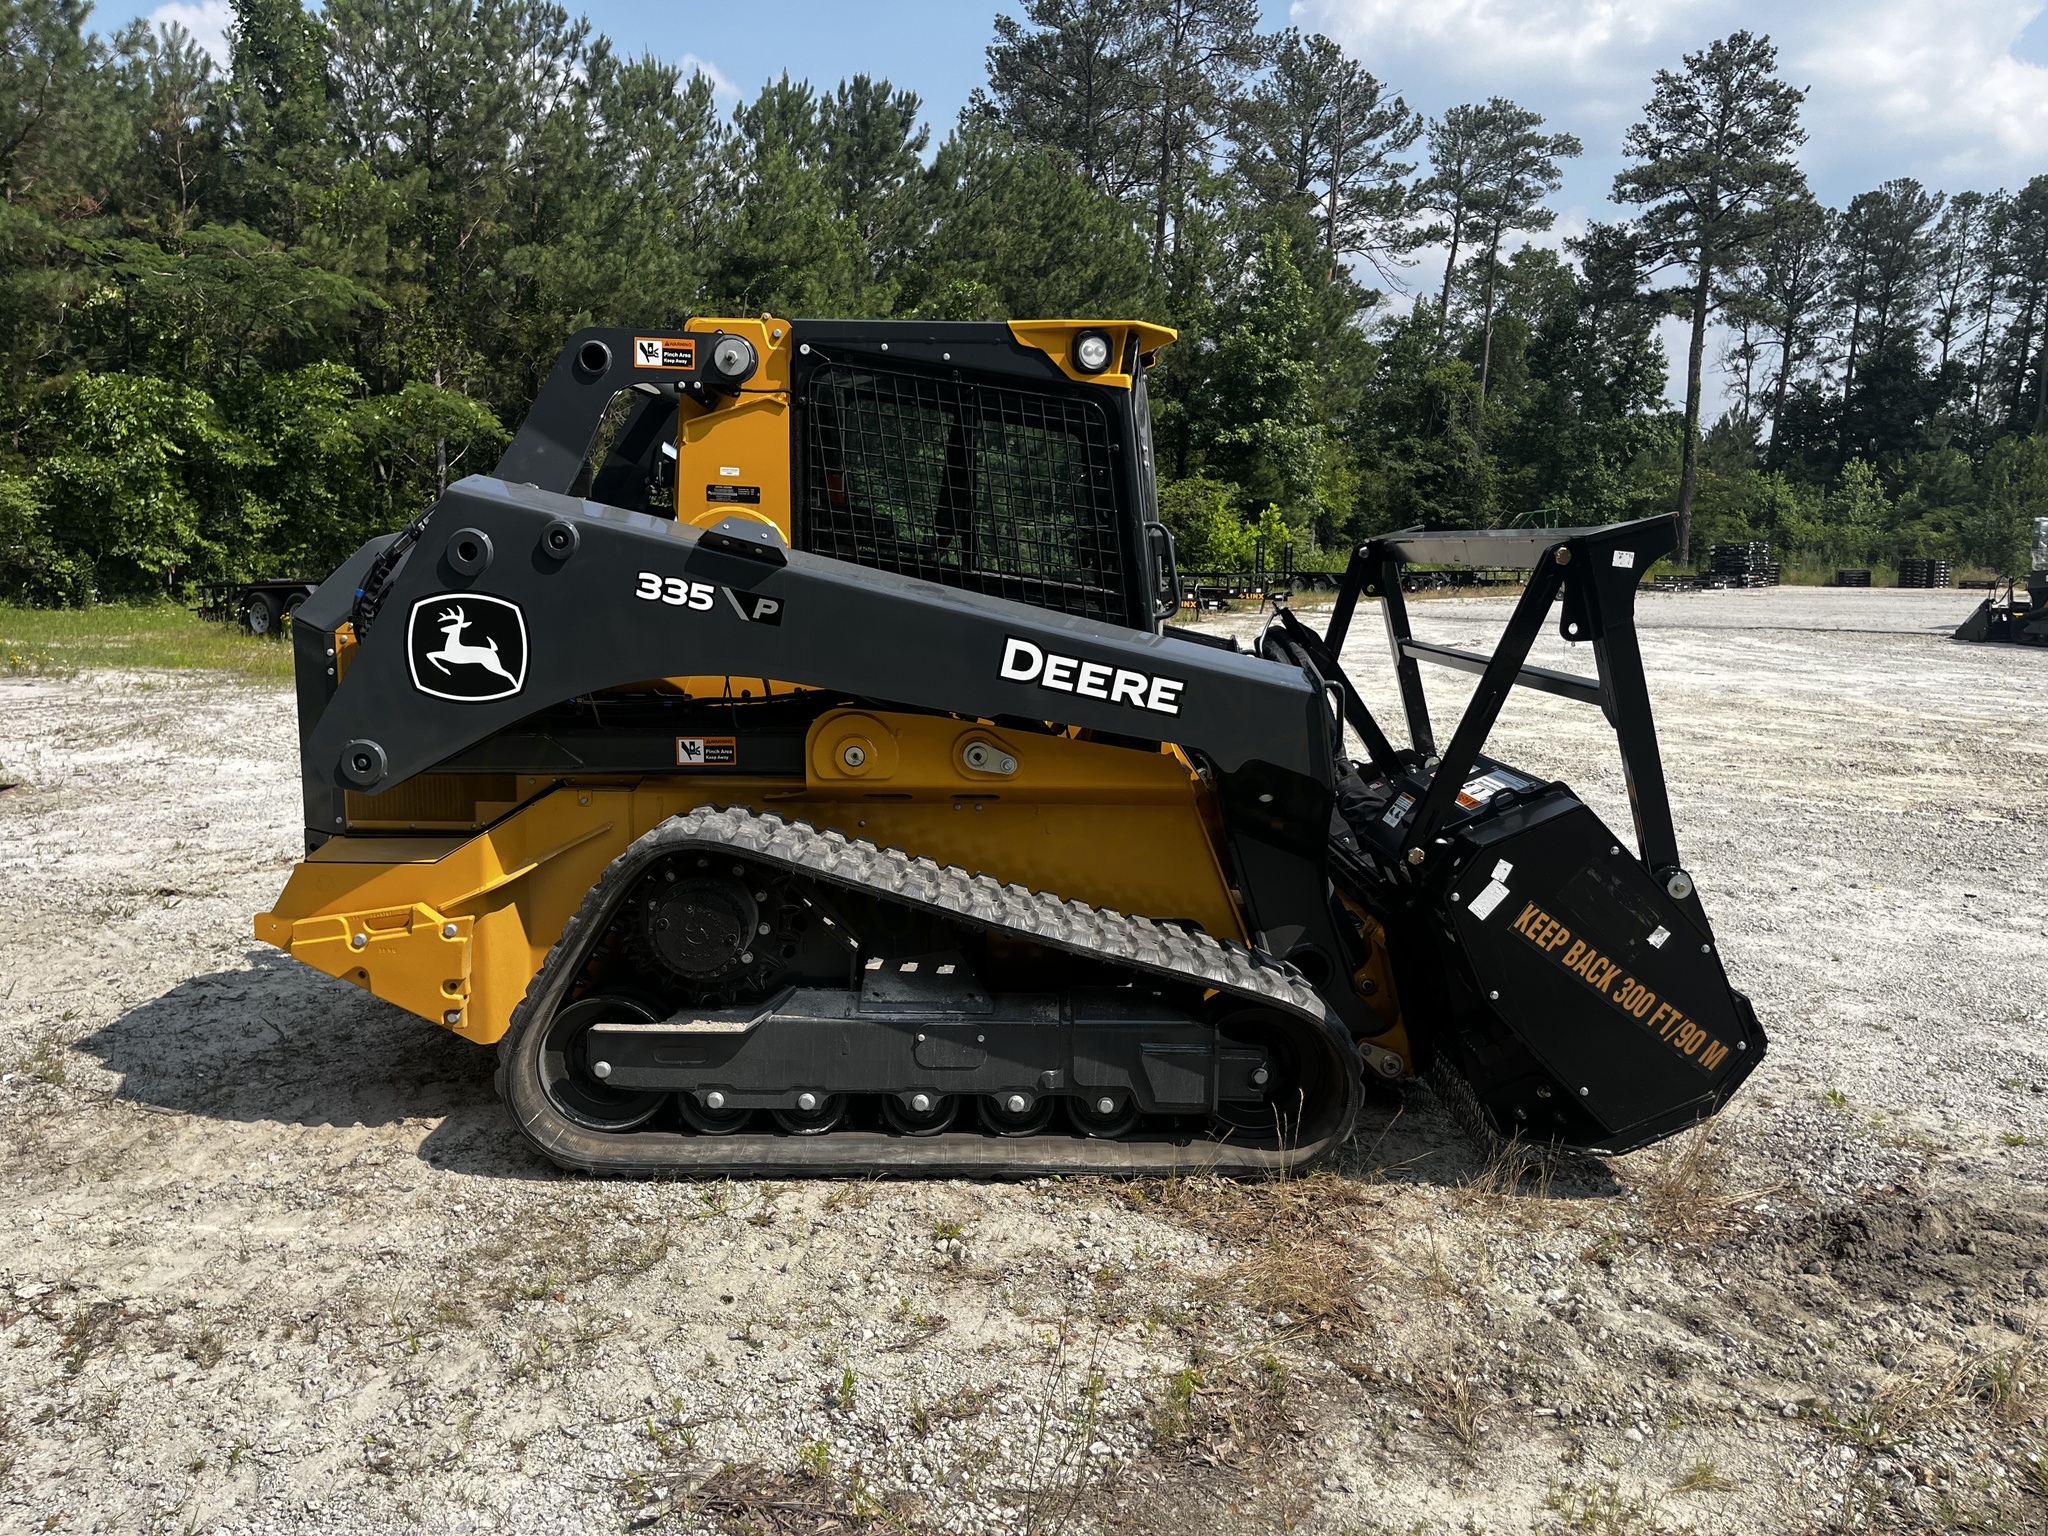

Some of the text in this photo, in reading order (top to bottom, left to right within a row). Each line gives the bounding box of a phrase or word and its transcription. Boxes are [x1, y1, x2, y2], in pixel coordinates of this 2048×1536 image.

[635, 572, 779, 619] 335 P
[1180, 600, 1197, 608] INX
[1000, 637, 1184, 715] DEERE
[1513, 904, 1729, 1071] KEEP BACK 300 FT/90 M
